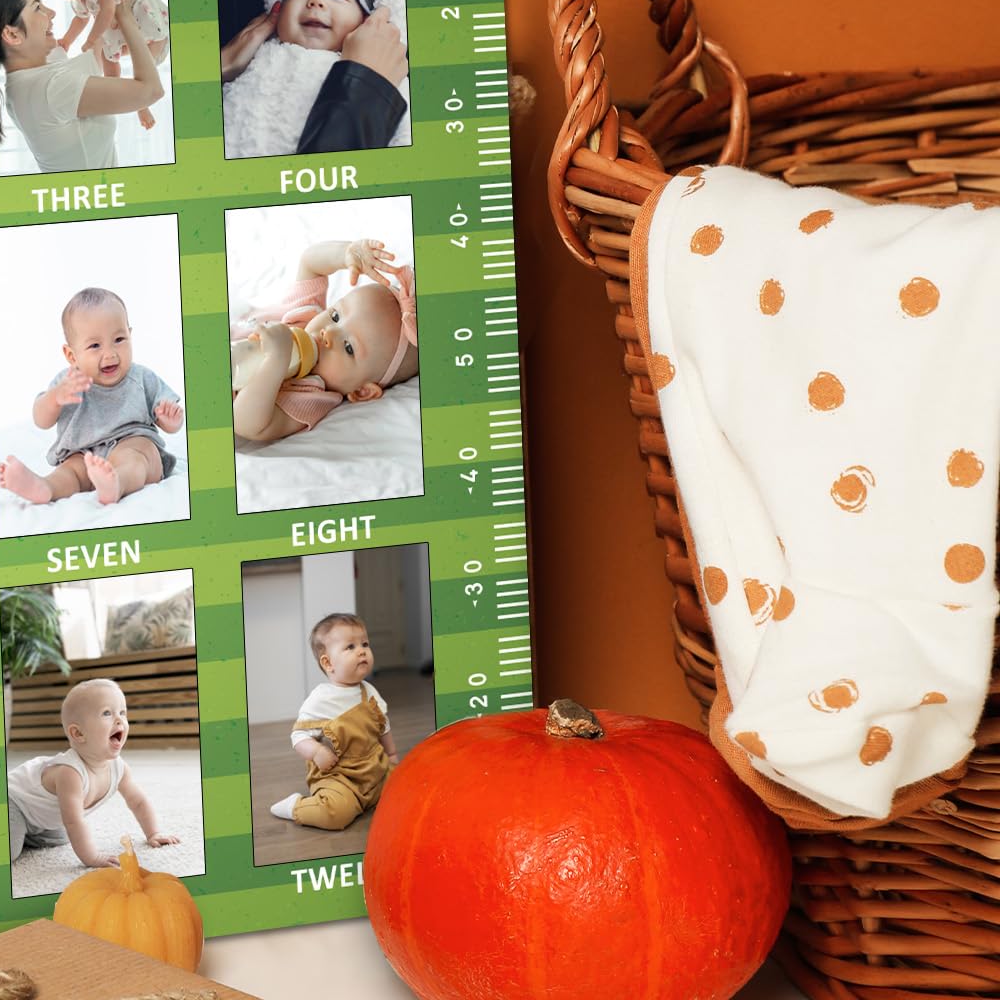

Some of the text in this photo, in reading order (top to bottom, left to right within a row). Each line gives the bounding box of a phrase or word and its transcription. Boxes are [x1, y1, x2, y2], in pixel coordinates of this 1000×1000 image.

[444, 96, 465, 134] 30
[31, 182, 127, 214] THREE
[279, 165, 360, 195] FOUR
[449, 212, 469, 249] 40
[454, 326, 475, 368] 50
[458, 446, 479, 484] 40
[290, 514, 377, 548] EIGHT
[46, 539, 142, 574] SEVEN
[463, 559, 484, 598] 30
[467, 672, 489, 709] 20
[290, 861, 364, 894] TWEL
